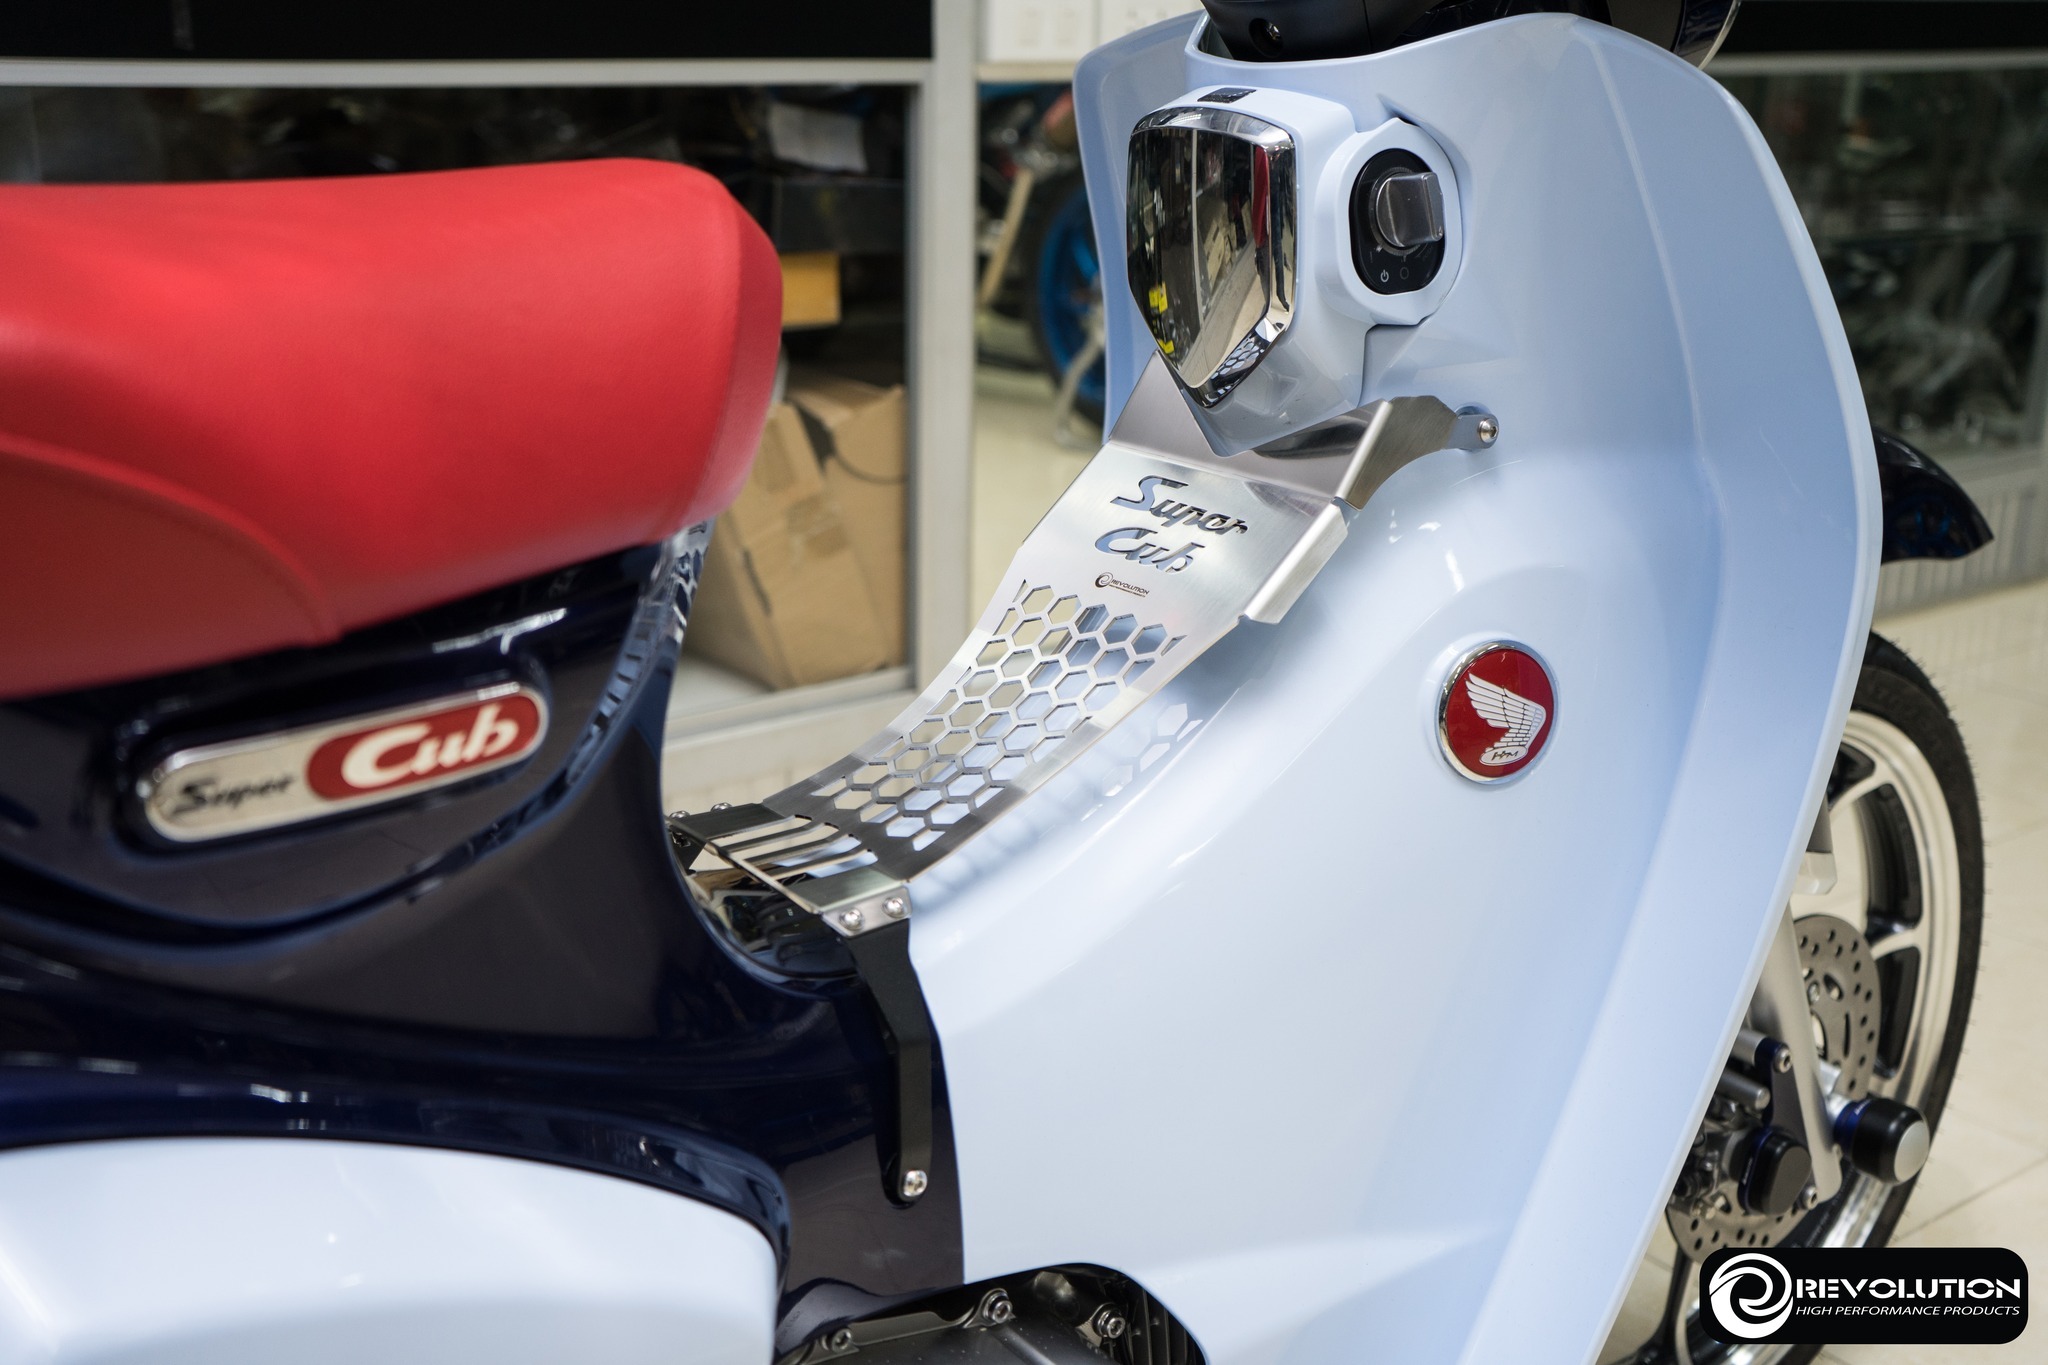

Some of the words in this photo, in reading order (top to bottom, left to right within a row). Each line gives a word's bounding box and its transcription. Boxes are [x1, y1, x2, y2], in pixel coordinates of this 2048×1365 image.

[1110, 475, 1249, 535] Super
[1095, 526, 1205, 574] Cub
[1110, 579, 1150, 595] REVOLUTION
[172, 772, 297, 815] Super
[341, 703, 520, 789] Cub
